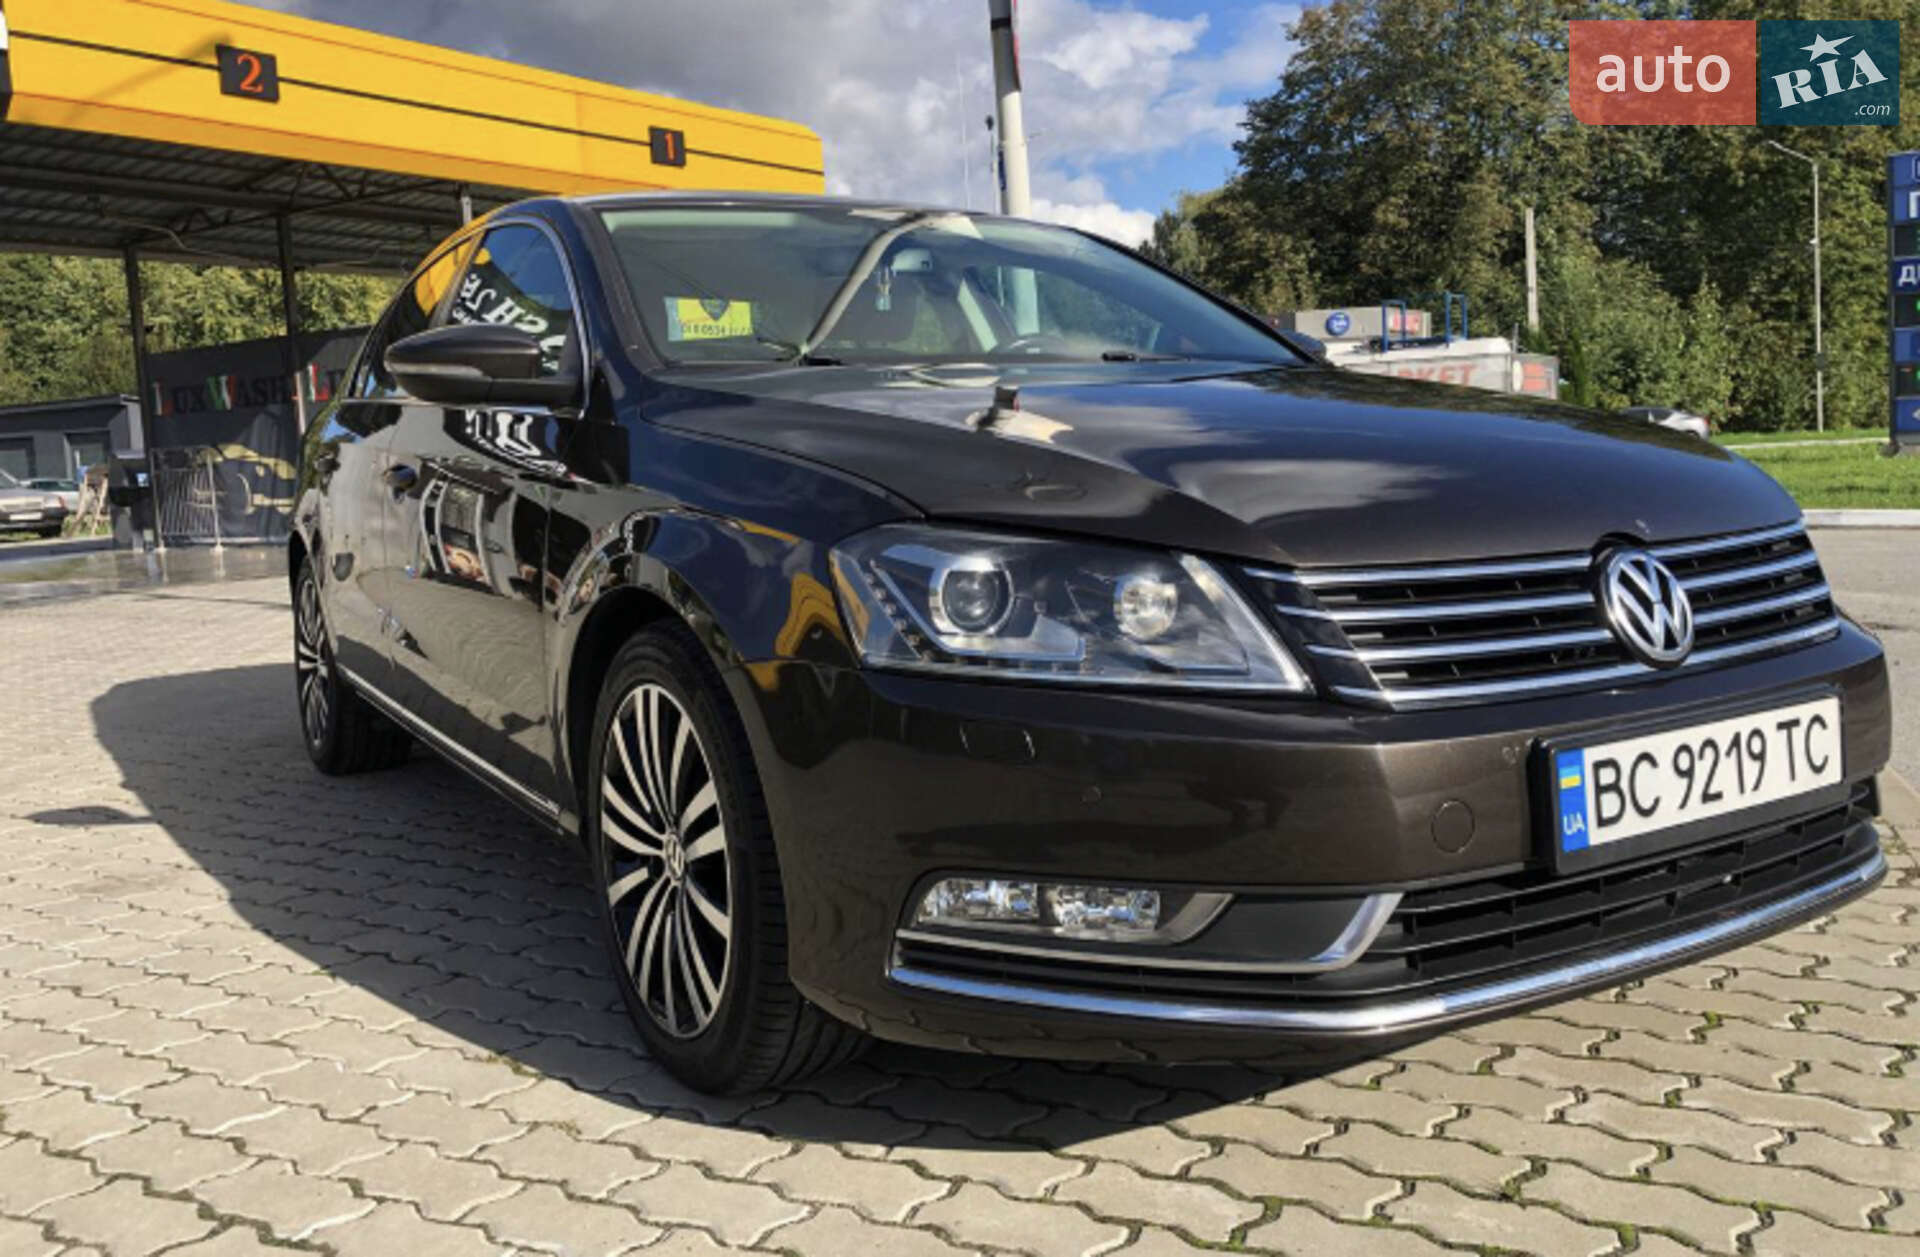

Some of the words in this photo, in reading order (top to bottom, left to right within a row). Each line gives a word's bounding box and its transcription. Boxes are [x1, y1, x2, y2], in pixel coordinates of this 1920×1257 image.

[237, 53, 263, 93] 2
[664, 132, 675, 161] 1
[1592, 751, 1661, 828] BC
[1672, 727, 1768, 811] 9219
[1775, 713, 1829, 782] TC
[1563, 815, 1586, 835] UA
